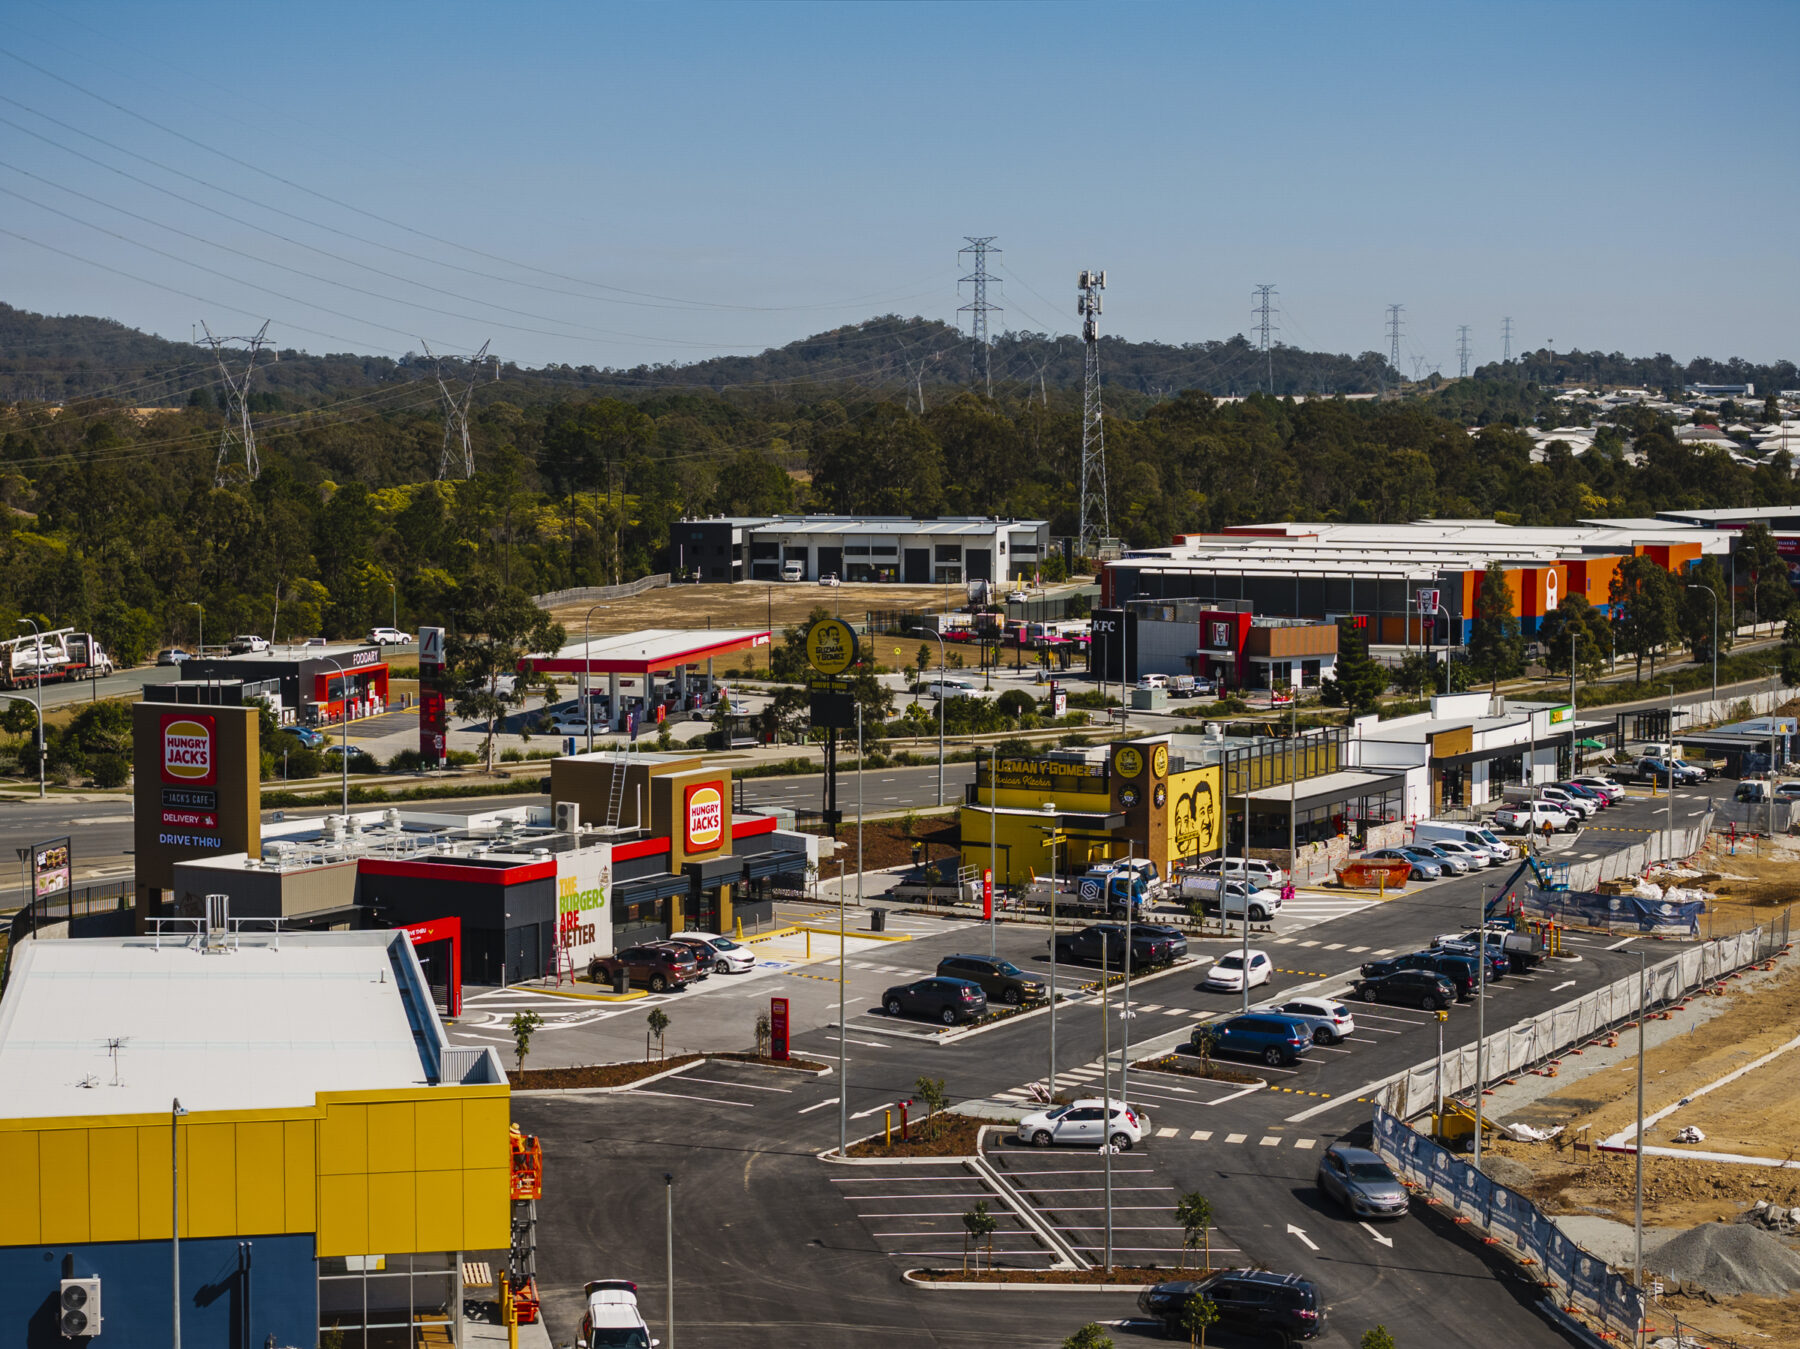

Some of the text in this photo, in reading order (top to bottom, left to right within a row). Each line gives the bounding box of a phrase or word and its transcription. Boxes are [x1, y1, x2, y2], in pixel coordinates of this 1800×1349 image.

[1092, 620, 1115, 632] KFC
[353, 650, 378, 665] FOODARY
[815, 646, 844, 654] GUZMAN
[167, 737, 207, 750] HUNGRY
[167, 748, 208, 765] JACK'S
[987, 759, 1091, 777] GUZMAN Y GOMEZ
[691, 803, 719, 817] HUNGRY
[163, 813, 199, 824] DELIVERY
[691, 814, 719, 832] JACK'S
[160, 833, 222, 848] DRIVE THRU
[559, 875, 577, 897] THE
[559, 887, 605, 915] BURGERS
[560, 910, 579, 934] ARE
